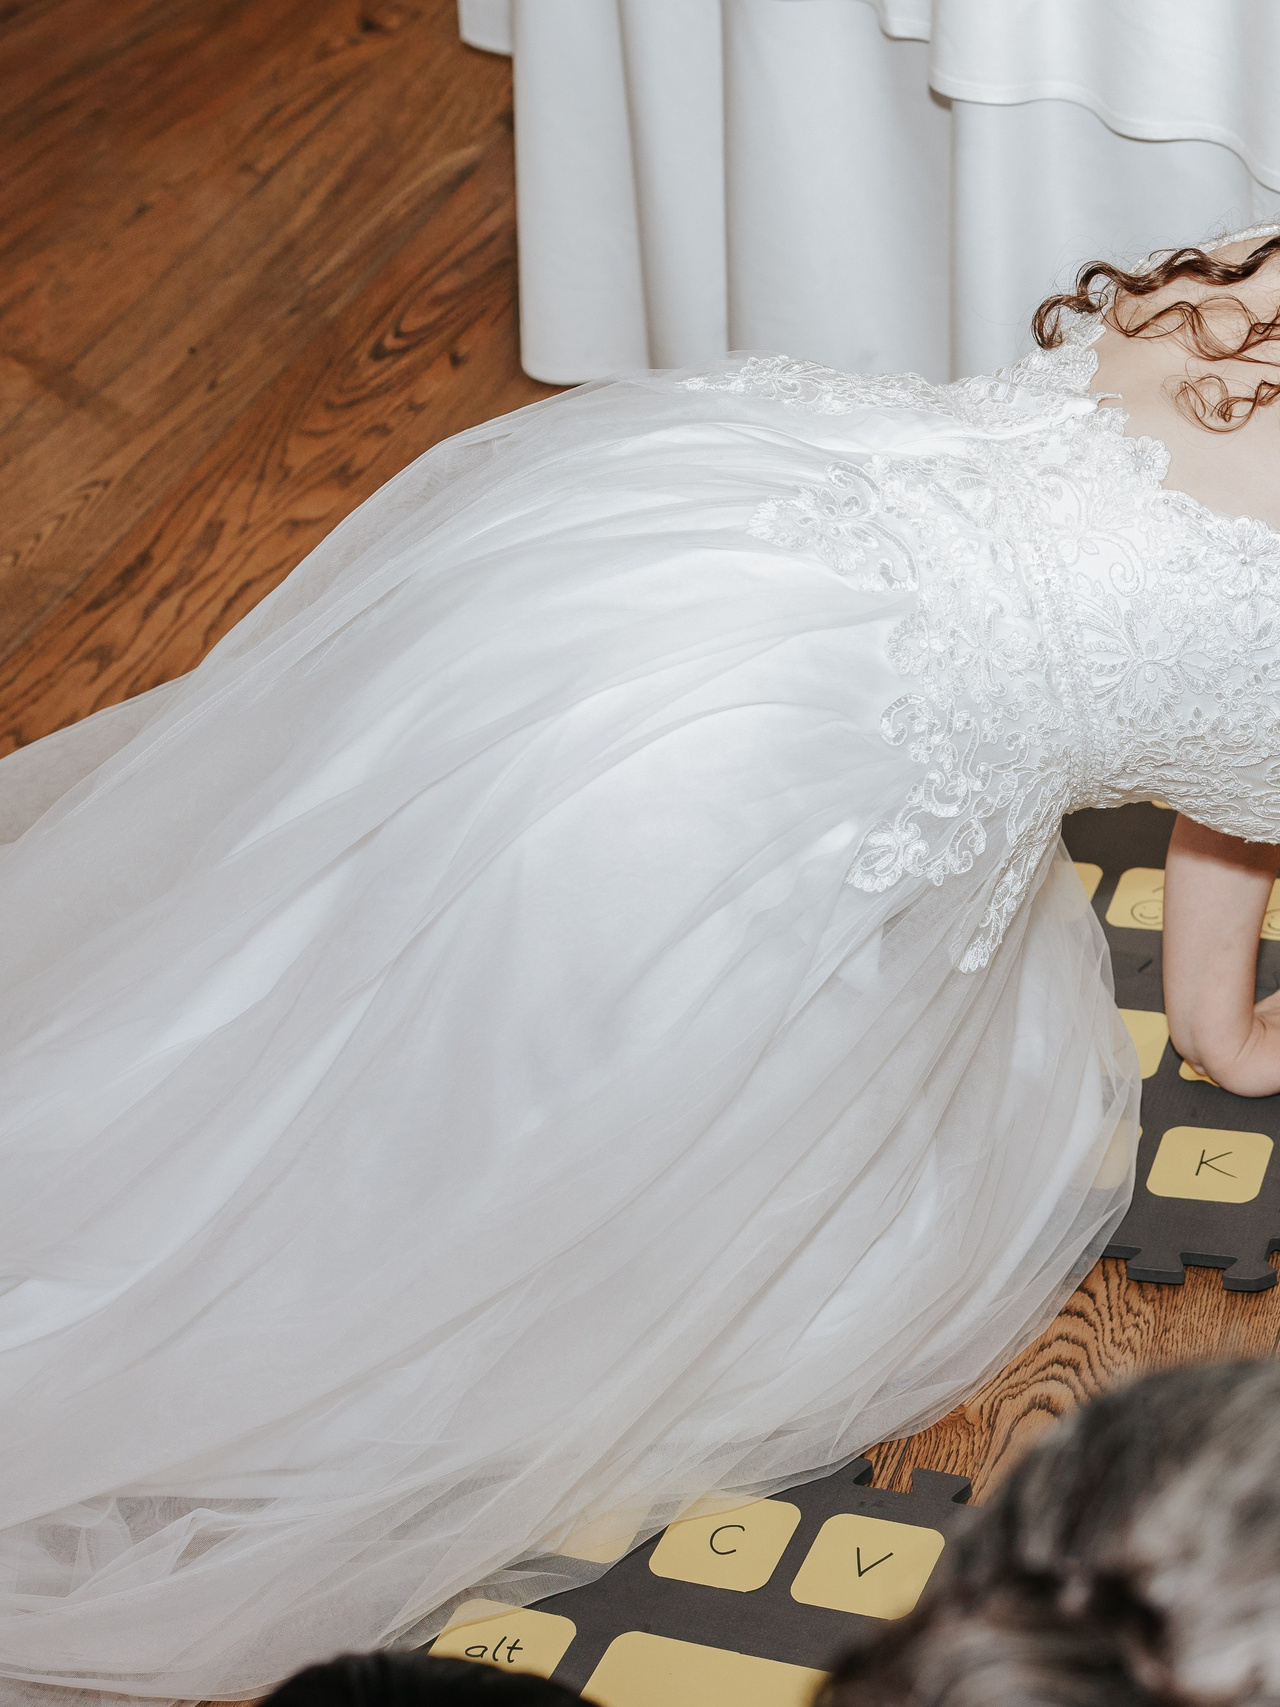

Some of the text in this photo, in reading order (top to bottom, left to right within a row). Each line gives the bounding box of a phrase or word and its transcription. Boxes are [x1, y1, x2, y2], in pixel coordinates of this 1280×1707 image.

[1194, 1148, 1239, 1180] K
[708, 1523, 747, 1556] C
[855, 1546, 895, 1579] V
[463, 1635, 524, 1664] alt
